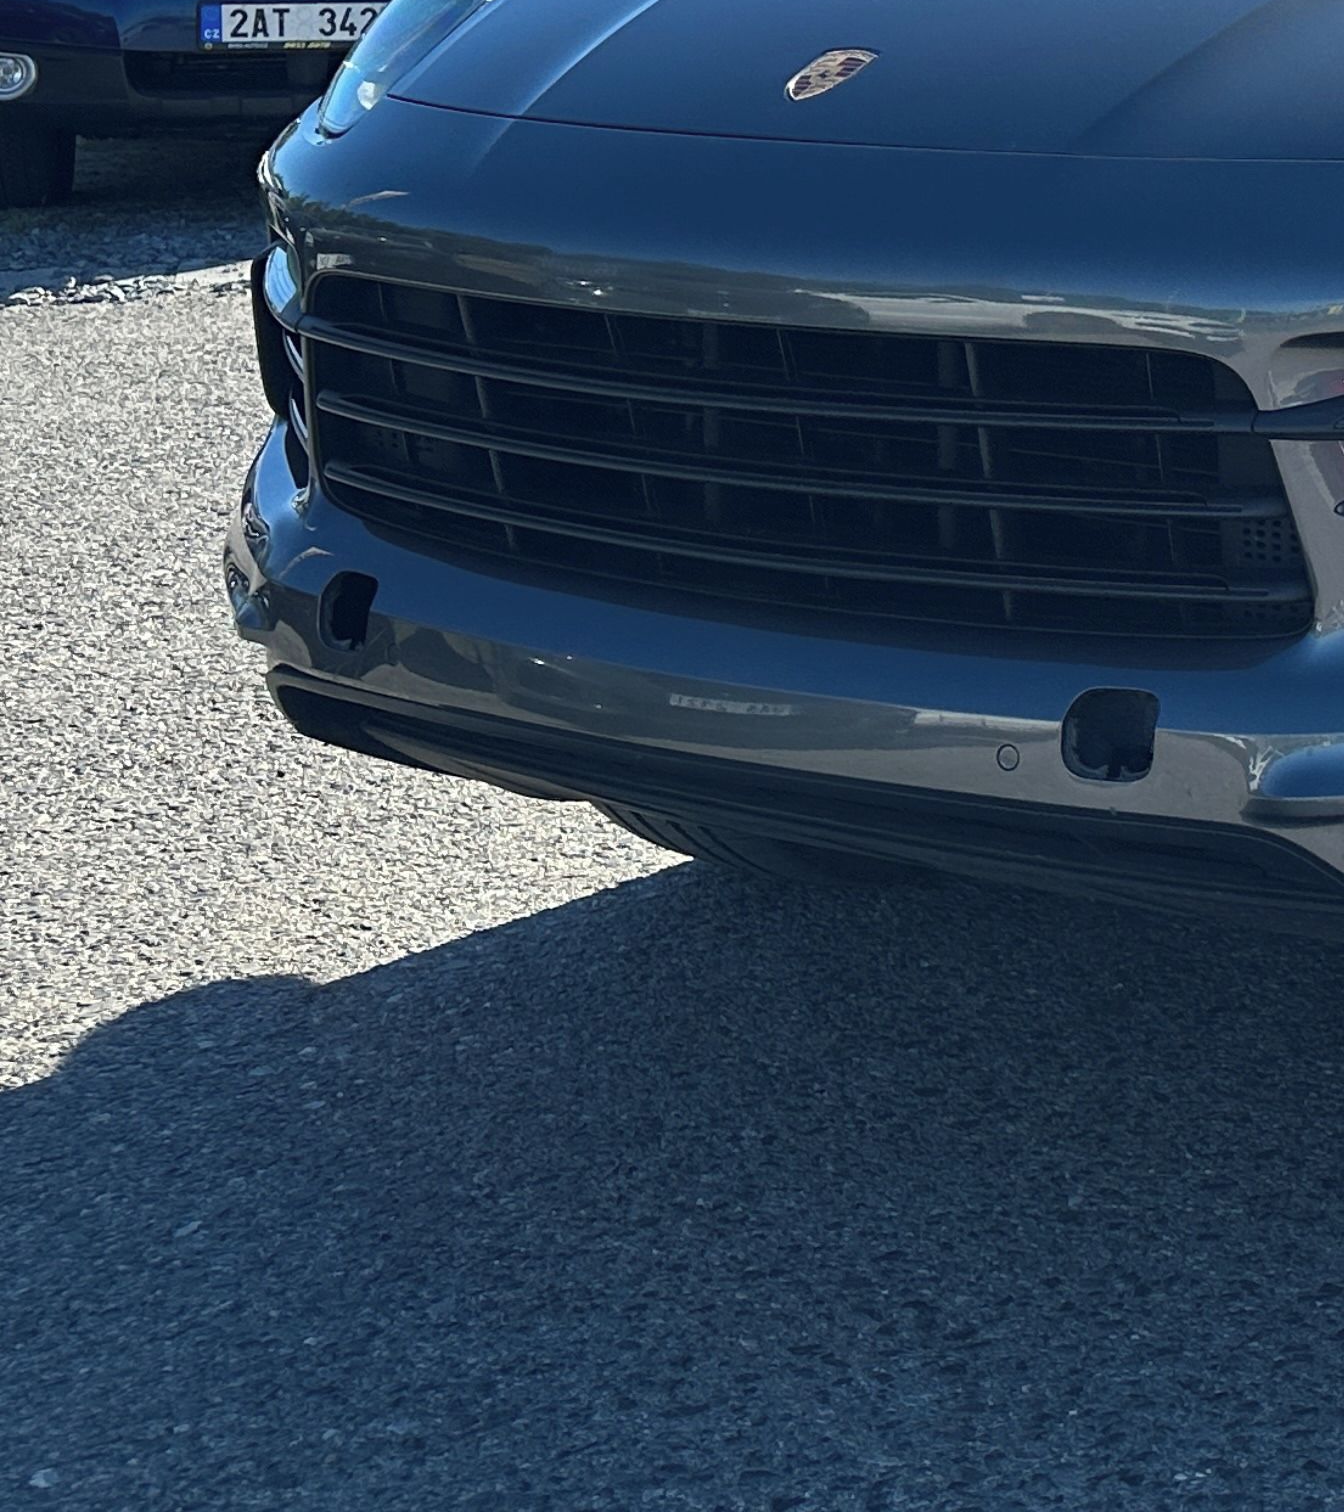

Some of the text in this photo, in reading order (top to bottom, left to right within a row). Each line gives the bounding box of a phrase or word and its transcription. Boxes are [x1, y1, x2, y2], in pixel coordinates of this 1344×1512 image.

[204, 7, 386, 39] CZ 2AT 342
